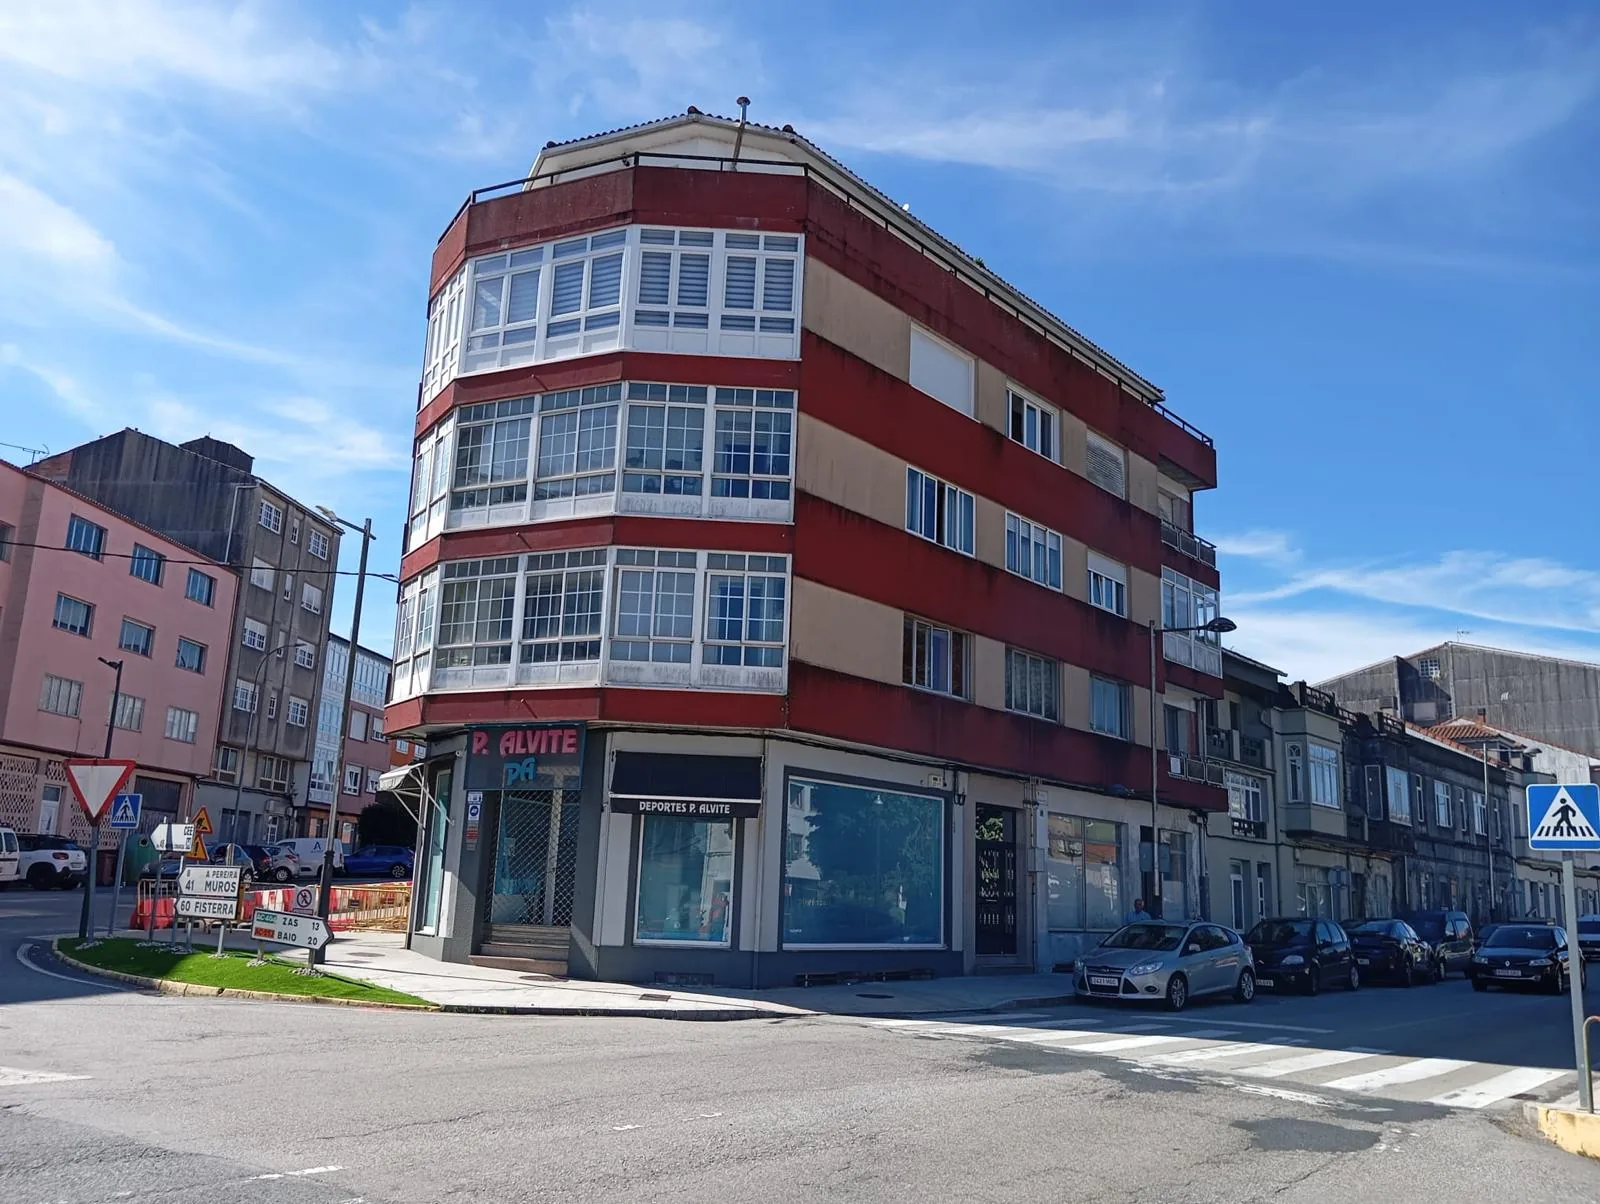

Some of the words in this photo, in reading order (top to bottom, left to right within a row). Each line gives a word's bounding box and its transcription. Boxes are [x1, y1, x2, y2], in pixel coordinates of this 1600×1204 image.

[472, 731, 489, 755] P.
[500, 729, 577, 757] ALVITE
[639, 801, 687, 813] DEPORTES
[689, 803, 697, 813] P.
[699, 803, 731, 814] ALVITE
[212, 870, 238, 879] PEREIRA
[185, 880, 194, 891] 41
[204, 880, 237, 893] MUROS
[180, 900, 191, 912] 60
[194, 901, 234, 916] FISTERRA
[282, 917, 298, 927] ZAS
[312, 921, 320, 931] 13
[277, 931, 297, 942] BAIO
[307, 936, 318, 946] 20
